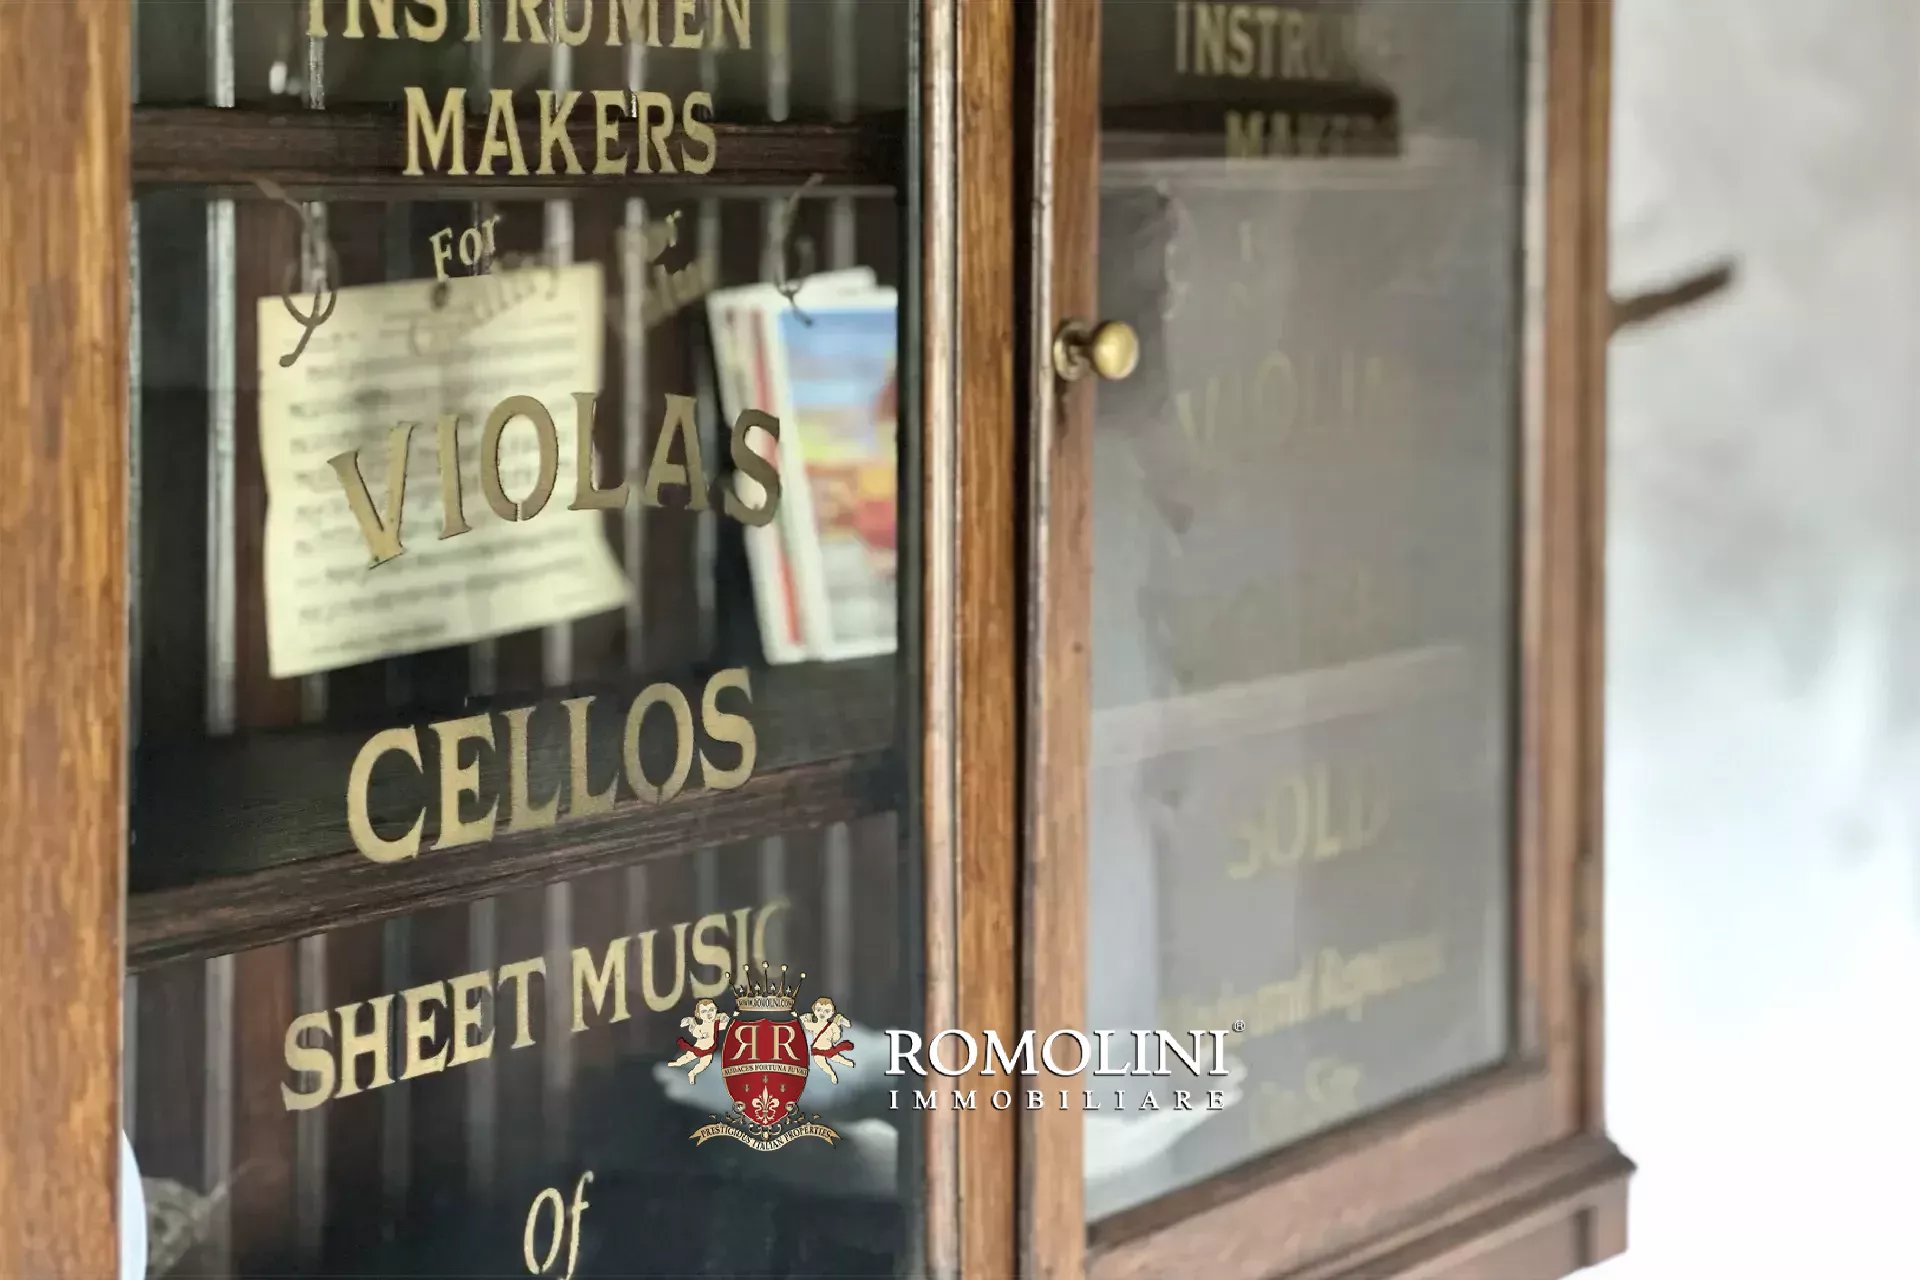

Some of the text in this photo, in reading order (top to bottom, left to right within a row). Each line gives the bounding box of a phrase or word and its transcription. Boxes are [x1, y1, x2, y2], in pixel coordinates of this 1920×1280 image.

[402, 87, 718, 176] MAKERS
[326, 392, 781, 569] VIOLAS
[346, 667, 757, 864] CELLOS
[279, 957, 546, 1112] SHEET
[524, 1170, 594, 1280] Of
